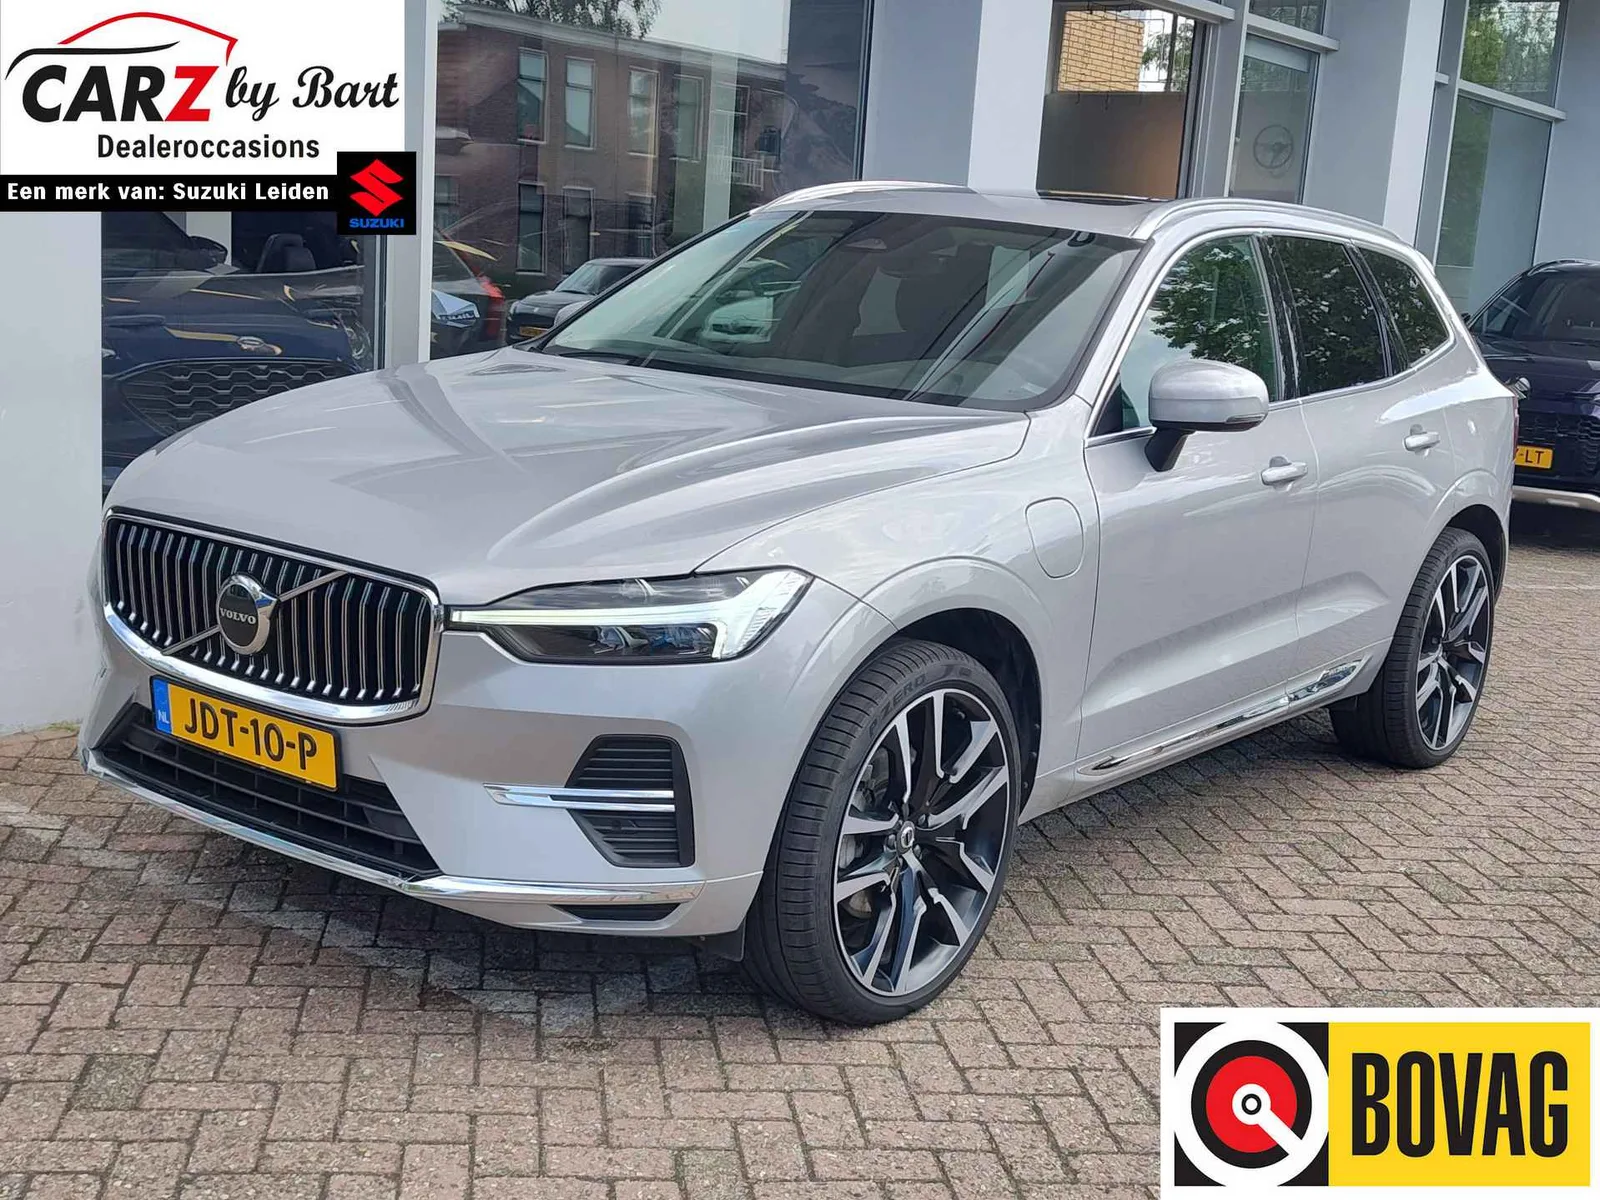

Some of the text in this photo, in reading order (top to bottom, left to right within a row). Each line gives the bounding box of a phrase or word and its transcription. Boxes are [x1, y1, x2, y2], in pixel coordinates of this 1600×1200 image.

[219, 607, 257, 625] VOLVO
[157, 710, 170, 724] NL
[184, 697, 318, 771] JDT-10-P
